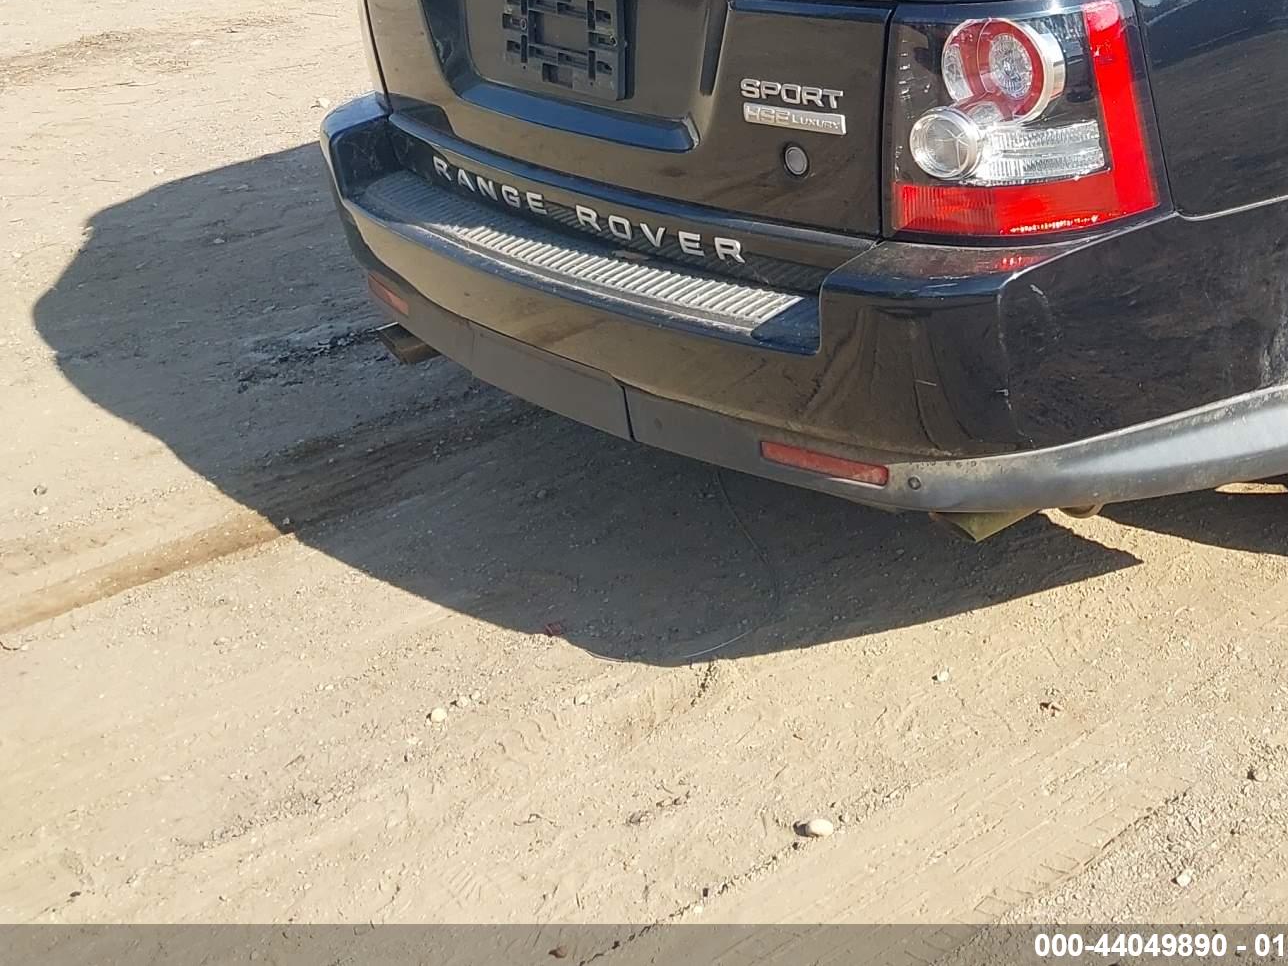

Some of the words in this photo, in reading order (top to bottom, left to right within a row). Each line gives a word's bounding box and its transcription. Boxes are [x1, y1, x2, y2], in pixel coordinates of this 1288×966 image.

[740, 78, 844, 109] SPORT
[745, 105, 790, 126] HSE
[791, 113, 841, 130] LUXURY
[432, 155, 548, 215] RANGE
[575, 204, 746, 264] ROVER
